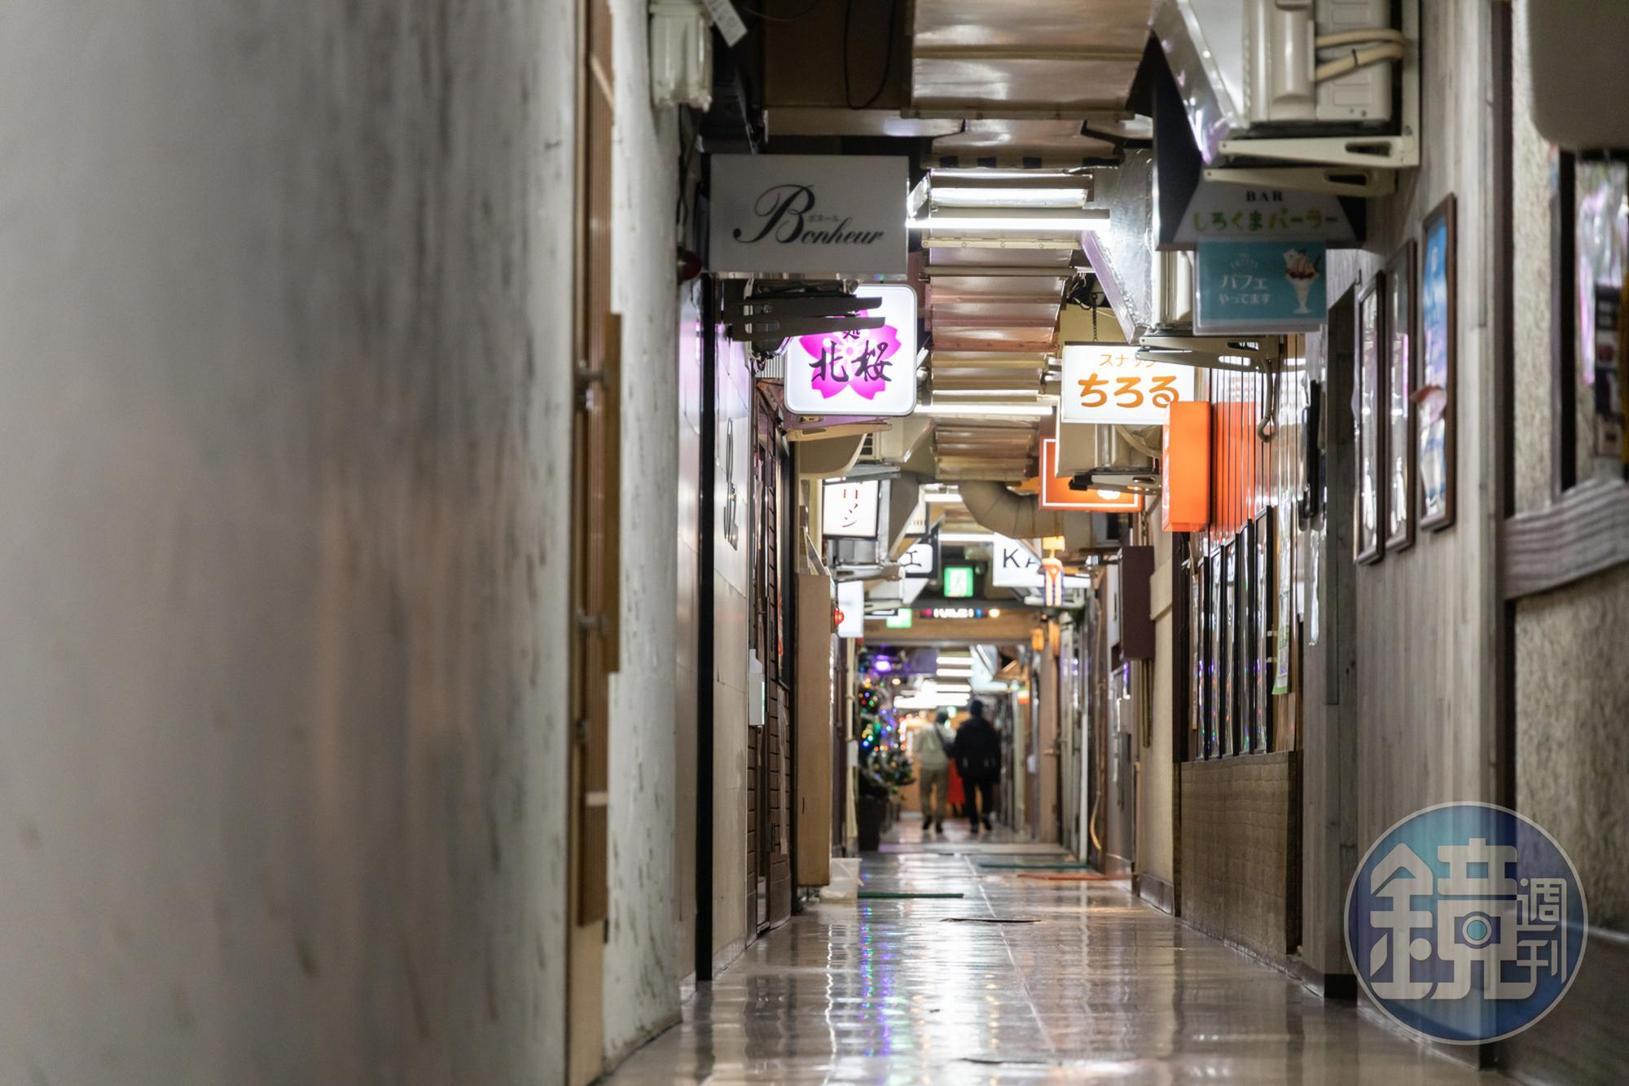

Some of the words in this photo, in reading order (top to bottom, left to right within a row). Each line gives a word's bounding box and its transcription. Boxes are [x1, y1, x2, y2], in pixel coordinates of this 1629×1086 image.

[1246, 190, 1283, 202] BAR
[733, 184, 884, 244] Bonheur
[1193, 207, 1338, 231] しろくまパーラー
[1220, 273, 1268, 290] パフェ
[809, 340, 893, 382] 北桜
[1078, 372, 1180, 409] ちろる
